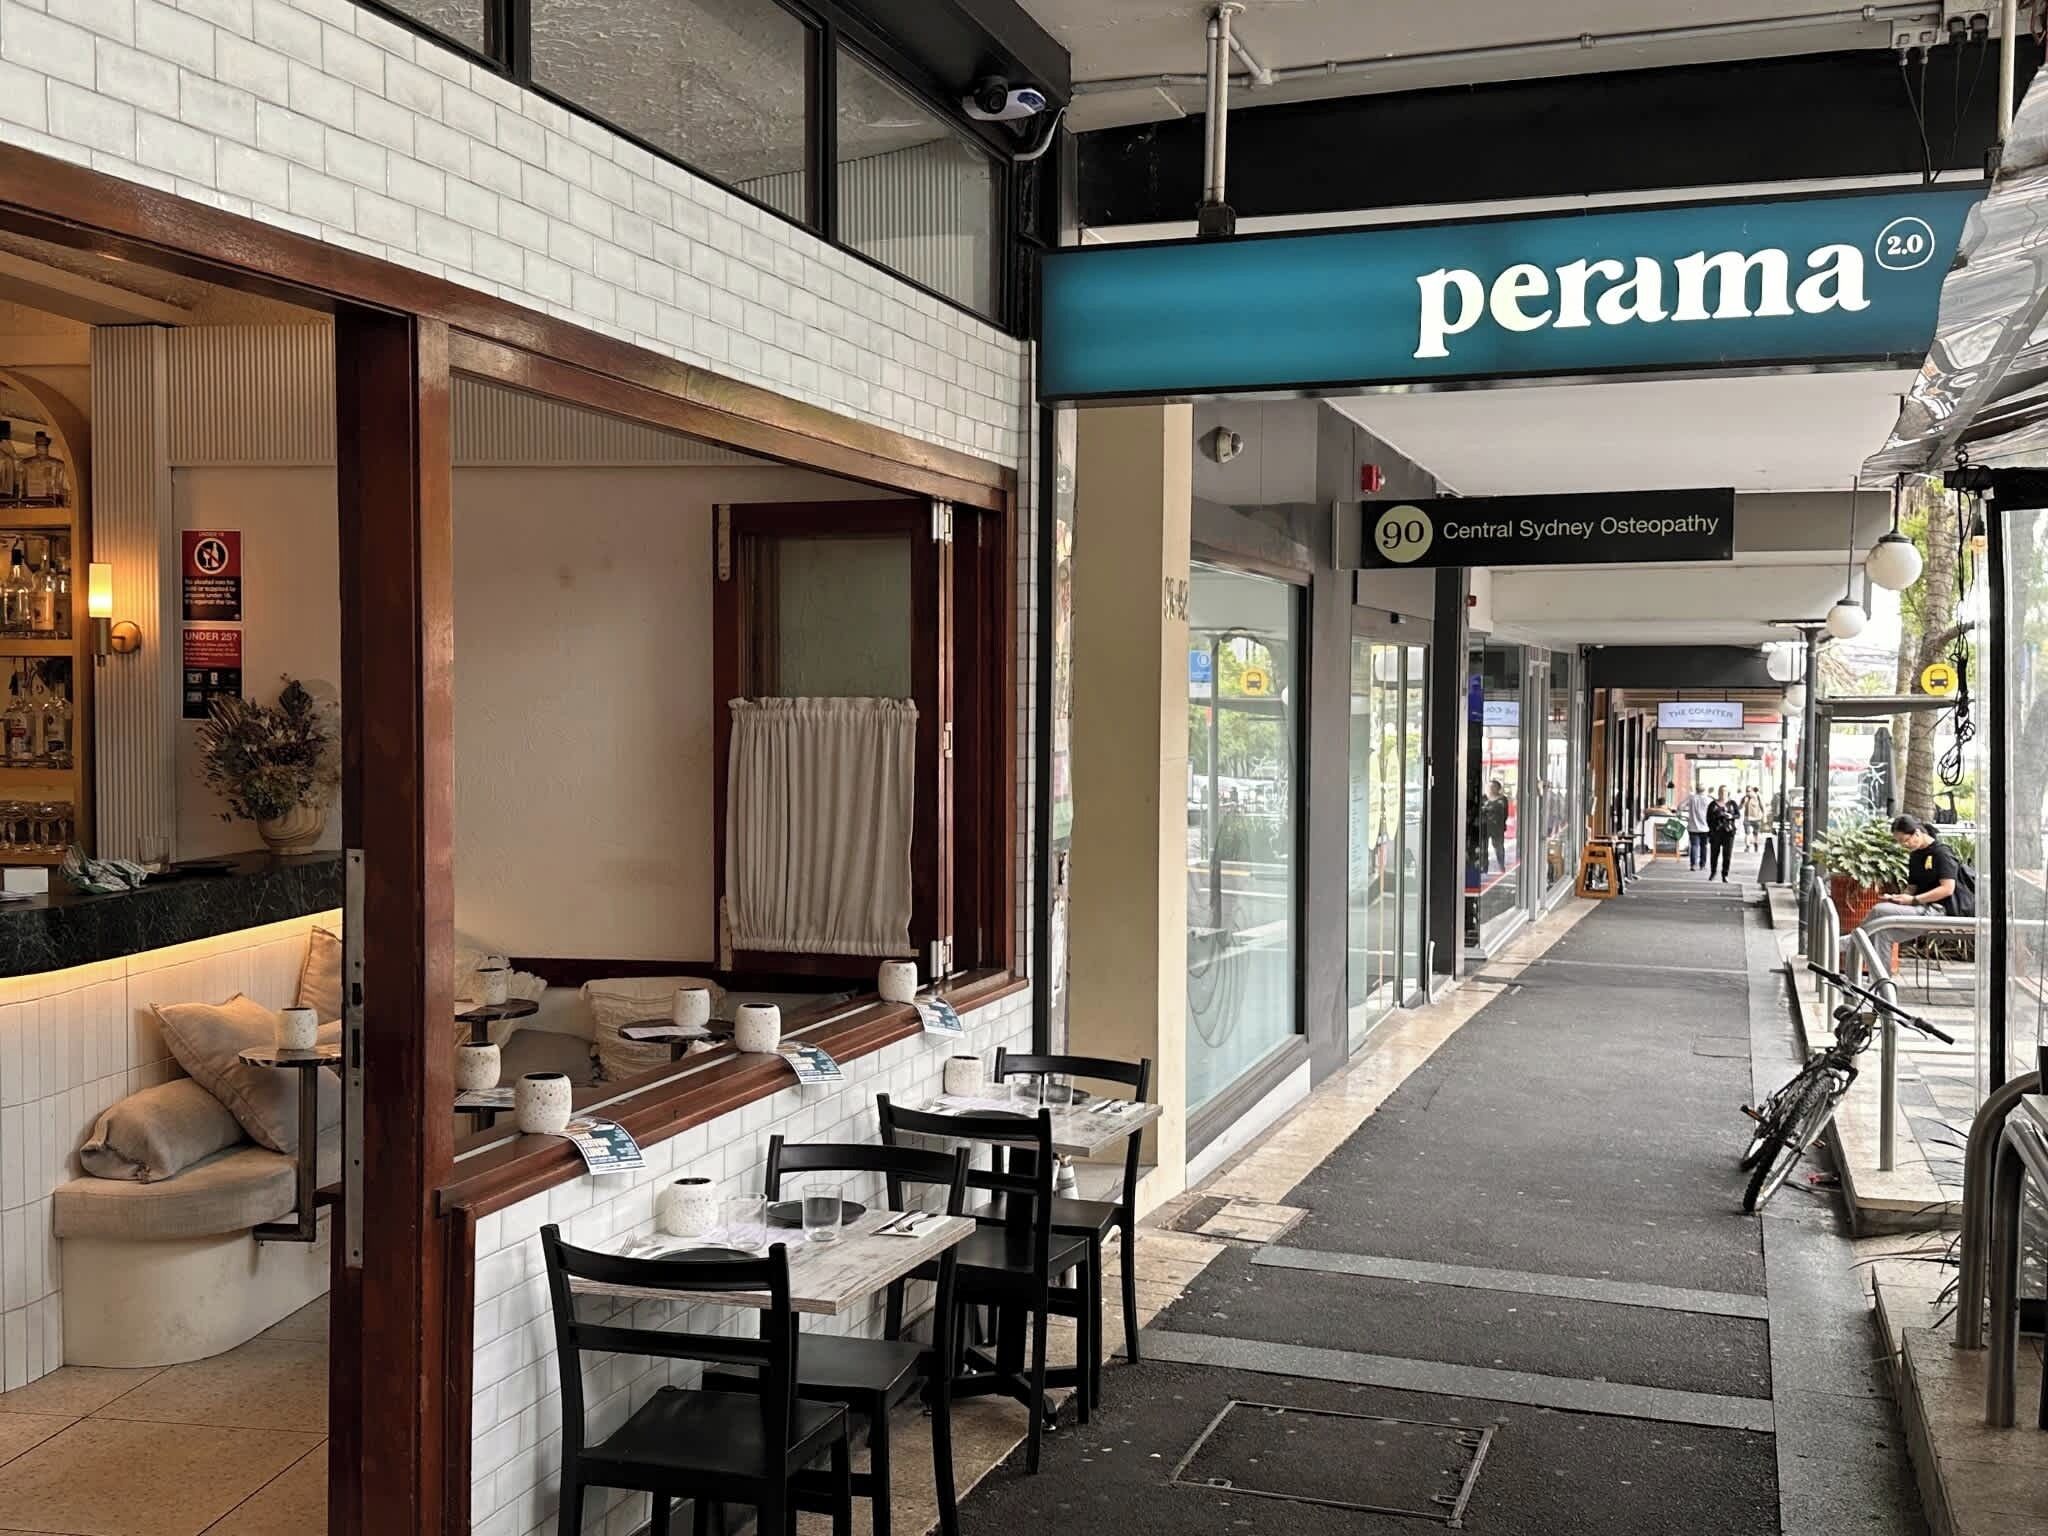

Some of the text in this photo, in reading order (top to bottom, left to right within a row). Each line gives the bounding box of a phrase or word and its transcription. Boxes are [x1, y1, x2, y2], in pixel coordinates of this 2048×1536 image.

[1888, 234, 1923, 255] 2.0
[1413, 243, 1871, 358] perama
[1382, 515, 1718, 549] 90 Central Sydney Osteopathy
[185, 631, 219, 641] UNDER
[1668, 709, 1686, 718] THE
